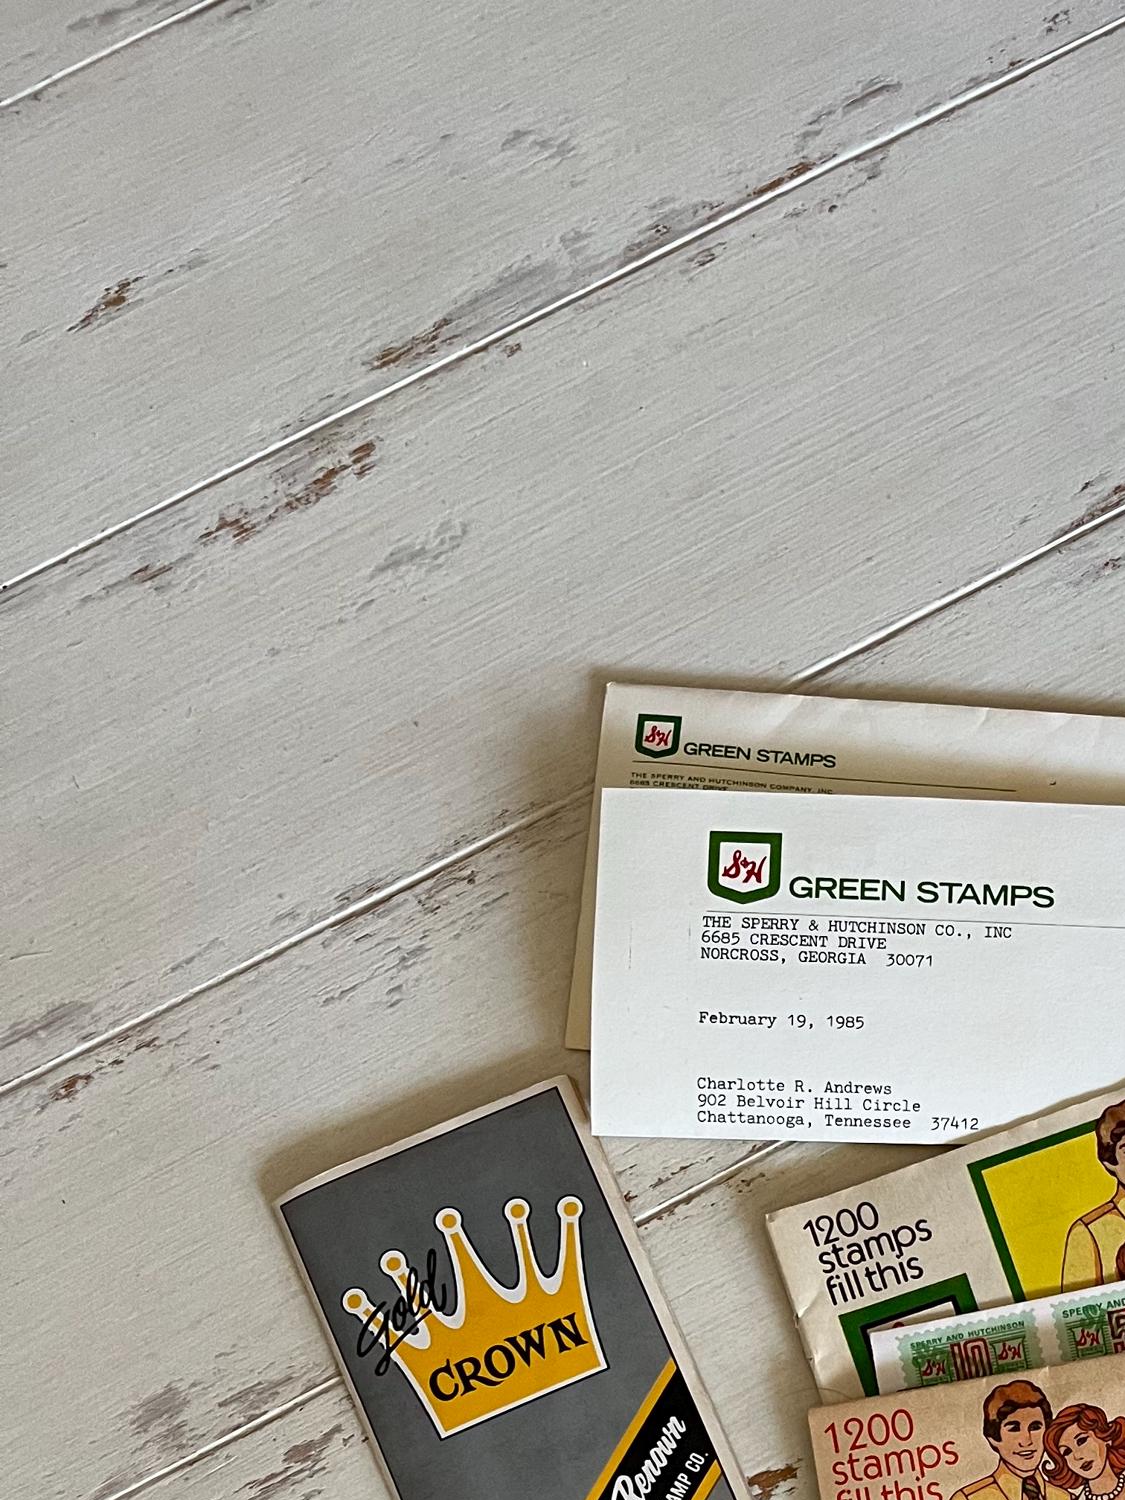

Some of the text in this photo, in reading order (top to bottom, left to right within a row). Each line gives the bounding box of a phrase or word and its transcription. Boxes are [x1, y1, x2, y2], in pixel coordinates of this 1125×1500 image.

[683, 741, 837, 768] GREEN STAMPS
[630, 772, 648, 780] THE
[687, 776, 706, 785] AND
[708, 778, 767, 789] HUTCHINSON
[788, 876, 1055, 909] GREEN STAMPS
[701, 931, 887, 950] 6685 CRESCENT DRIVE
[702, 916, 1013, 939] THE SPERRY & HUTCHINSON CO., INC
[700, 948, 934, 967] NORCROSS, GEORGIA 30071
[698, 1011, 865, 1030] February 19, 1985
[697, 1077, 892, 1096] Charlotte R. Andrews
[697, 1094, 921, 1113] 902 Belvoir Hill Circle
[697, 1111, 979, 1131] Chattanooga, Tennessee 37412
[803, 1201, 879, 1248] 1200
[818, 1218, 933, 1274] stamps
[825, 1256, 924, 1306] fill this
[356, 1249, 452, 1376] Gold
[945, 1332, 964, 1343] AND
[967, 1320, 1025, 1337] HUTCHINSON
[428, 1312, 588, 1403] CROWN
[824, 1408, 914, 1455] 1200
[685, 1450, 710, 1477] CO.
[832, 1437, 960, 1486] stamps
